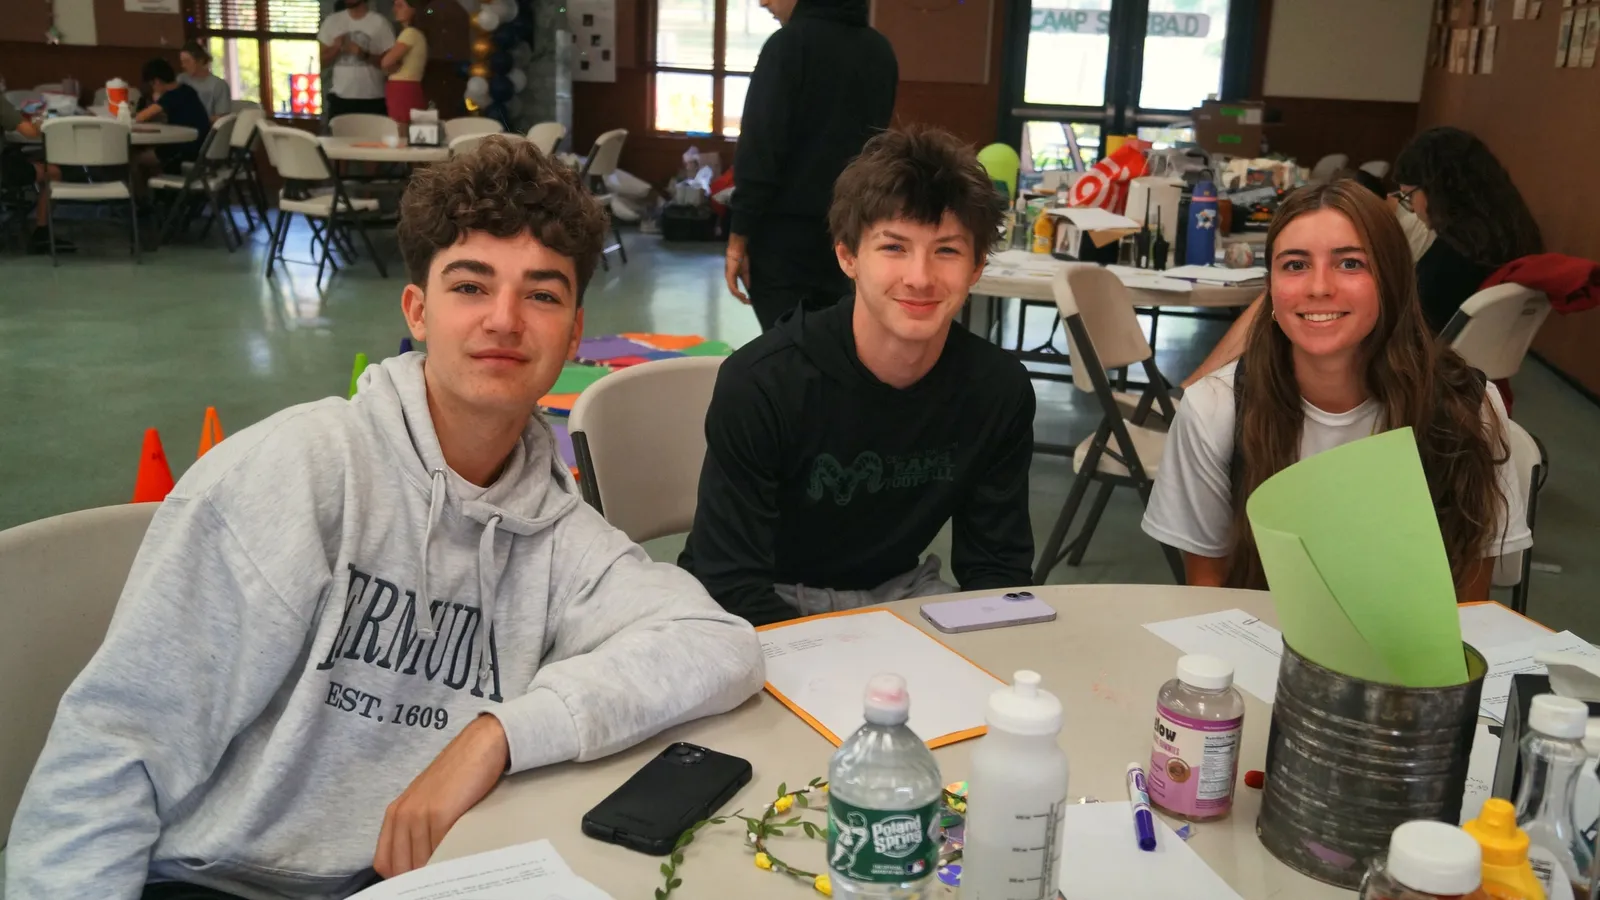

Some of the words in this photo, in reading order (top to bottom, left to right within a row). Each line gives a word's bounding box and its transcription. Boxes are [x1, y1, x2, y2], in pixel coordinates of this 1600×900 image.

[1031, 10, 1087, 32] CAMP
[1096, 13, 1200, 37] SBAD
[316, 562, 504, 704] ERMUDA
[324, 681, 384, 723] EST.
[391, 704, 449, 730] 1609
[872, 814, 922, 838] Poland
[874, 831, 923, 854] Spring
